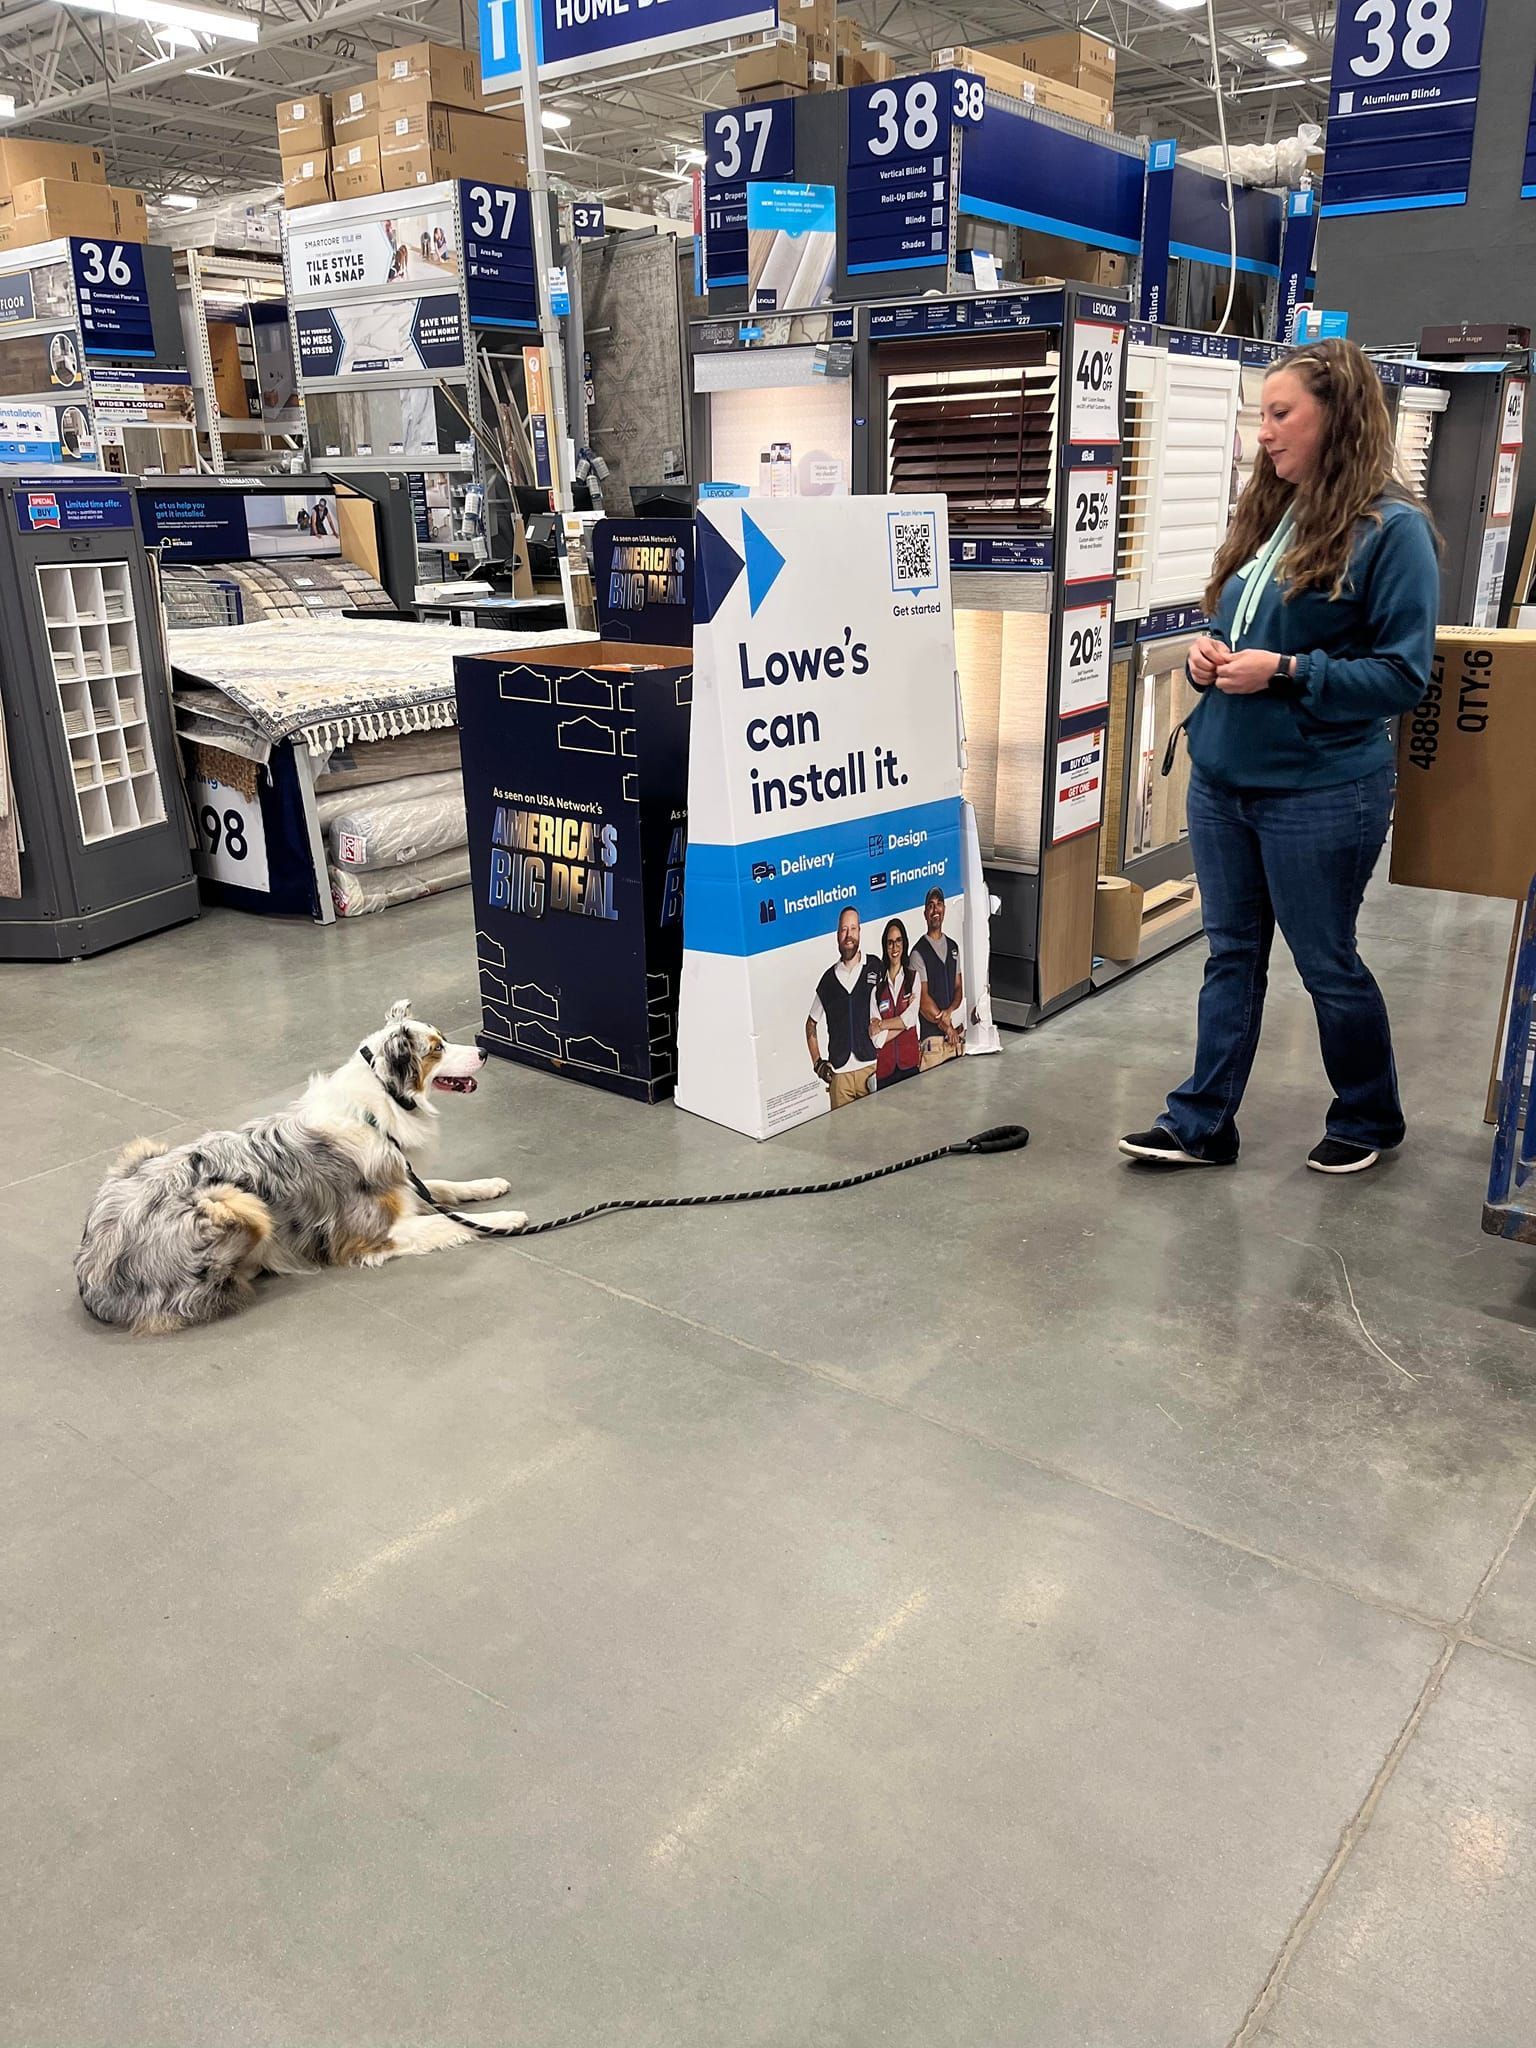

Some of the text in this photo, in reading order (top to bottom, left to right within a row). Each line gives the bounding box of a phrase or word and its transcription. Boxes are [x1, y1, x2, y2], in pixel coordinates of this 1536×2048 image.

[1350, 0, 1452, 77] 38
[953, 78, 985, 122] 38
[1362, 87, 1441, 106] Aluminum Blinds
[868, 81, 938, 156] 38
[714, 108, 773, 178] 37
[880, 165, 927, 180] Vertical Blinds
[724, 191, 747, 201] Drapery
[881, 189, 928, 204] Roll-Up Blinds
[469, 186, 517, 240] 37
[574, 209, 602, 228] 37
[905, 214, 926, 225] Blinds
[304, 236, 340, 249] SMARTCORE
[901, 239, 926, 250] Shades
[80, 242, 132, 286] 36
[306, 254, 364, 273] TILE STYLE
[309, 268, 365, 286] IN A SNAP
[1287, 273, 1298, 306] Blinds
[1092, 302, 1117, 317] LEVOLOR
[1149, 285, 1159, 323] Blinds
[419, 315, 459, 328] SAVE TIME
[871, 315, 894, 323] LEVOLOR
[301, 335, 332, 346] NO MESS
[420, 329, 437, 337] SAVE
[302, 346, 333, 355] NO STRESS
[1076, 350, 1113, 391] 40%
[1102, 380, 1113, 391] OFF
[98, 401, 124, 409] WIDER
[37, 508, 52, 517] BUY
[65, 500, 122, 508] Limited time offer.
[176, 502, 191, 511] help
[192, 503, 205, 511] you
[1075, 493, 1108, 531] 25%
[155, 511, 168, 519] get
[639, 535, 650, 543] USA
[608, 572, 686, 611] BIG DEAL
[893, 602, 941, 617] Get started
[1069, 626, 1102, 668] 20%
[738, 626, 870, 689] Lowe's
[1457, 650, 1493, 733] QTY:6
[746, 711, 820, 752] can
[1070, 753, 1092, 770] BUY ONE
[750, 746, 909, 815] install it.
[1068, 781, 1090, 798] GET ONE
[493, 787, 603, 815] As seen on USA Network's
[670, 810, 681, 820] As
[888, 829, 928, 850] Design
[780, 851, 835, 876] Delivery
[489, 847, 619, 921] BIG DEAL
[784, 884, 857, 914] Installation
